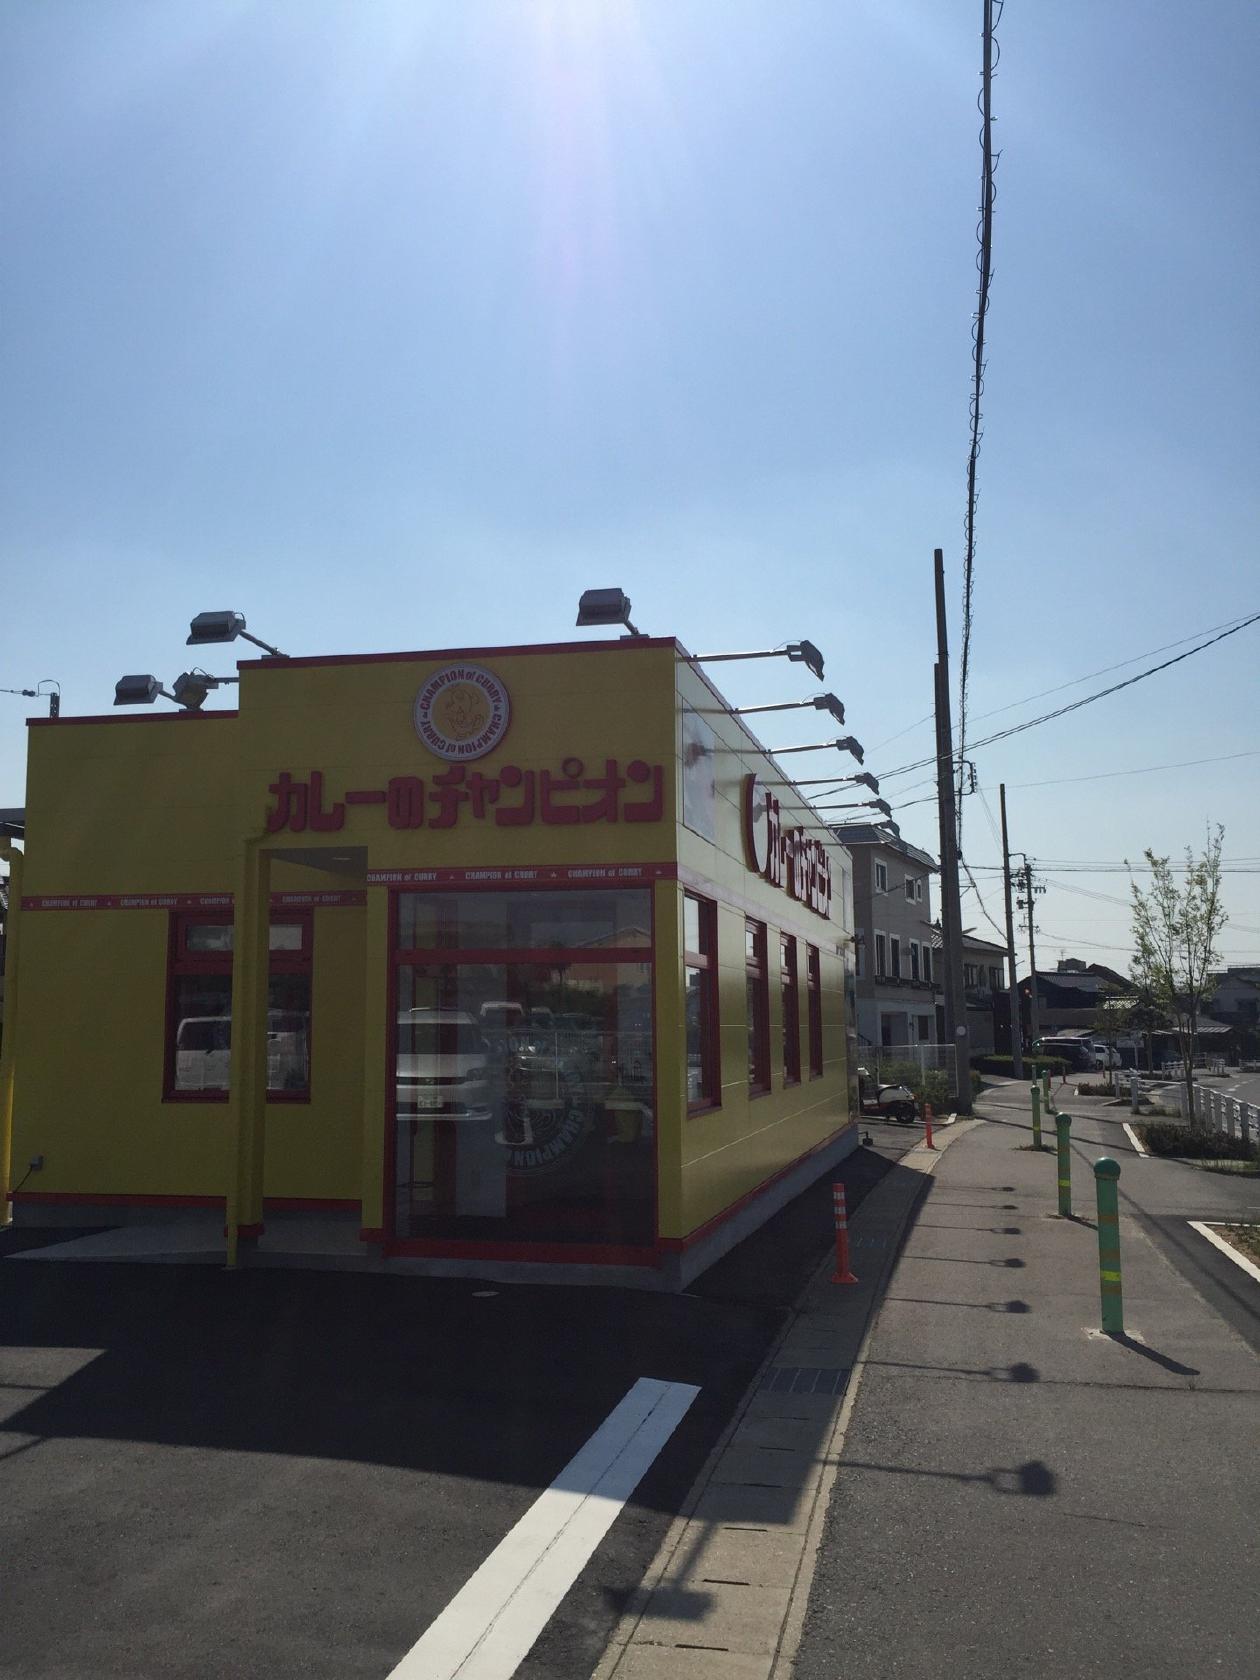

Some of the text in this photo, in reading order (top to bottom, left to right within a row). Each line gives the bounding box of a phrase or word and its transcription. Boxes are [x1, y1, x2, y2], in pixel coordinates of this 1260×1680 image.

[420, 669, 502, 710] CHAMPION of CURRY
[420, 720, 446, 750] CURRY
[458, 713, 502, 754] CHAMPION
[267, 757, 663, 833] カレーのチャンピオン
[367, 872, 402, 882] CHAMPION
[414, 872, 437, 881] CURRY
